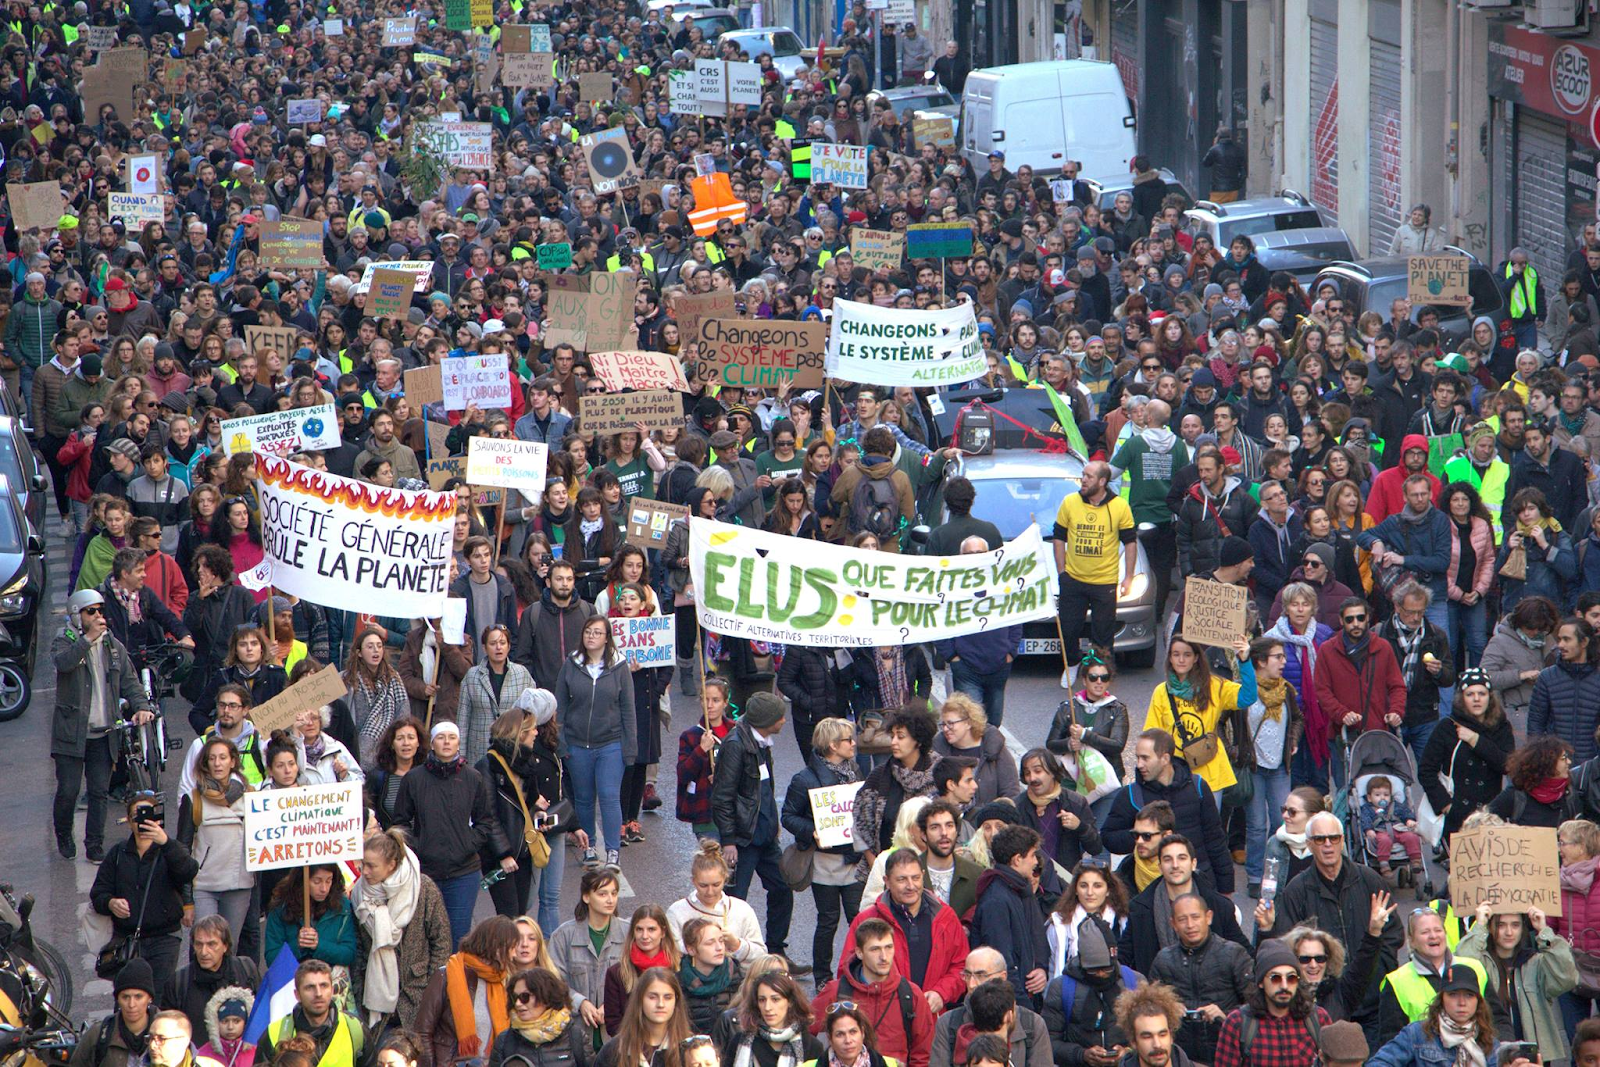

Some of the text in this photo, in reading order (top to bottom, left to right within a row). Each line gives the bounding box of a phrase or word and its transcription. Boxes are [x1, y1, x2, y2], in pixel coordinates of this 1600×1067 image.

[699, 67, 720, 77] CRS
[1556, 51, 1589, 78] AZUR
[676, 82, 685, 90] ET
[700, 78, 719, 86] C'EST
[735, 79, 757, 87] VOTRE
[1556, 72, 1589, 98] SCOOT
[677, 103, 698, 112] TOUT
[581, 135, 594, 147] LA
[814, 144, 866, 160] JE VOTE
[821, 158, 866, 174] POUR LA
[617, 174, 640, 188] NOIR
[110, 204, 138, 213] C'EST
[111, 195, 148, 206] QUAND
[1410, 257, 1467, 271] SAVE THE
[577, 273, 625, 297] NON
[1411, 270, 1470, 288] PLANET
[553, 295, 635, 322] AUX GAZ
[701, 318, 810, 356] Changeons
[840, 319, 938, 340] CHANGEONS
[589, 352, 661, 369] Ni Dieu
[697, 341, 829, 372] le SYSTÈME pas
[838, 340, 935, 363] LE SYSTÈME
[443, 357, 503, 372] TOI AUSSI
[594, 365, 669, 381] Ni Maître
[697, 361, 805, 387] le CLIMAT
[584, 394, 675, 408] EN 2050 IL Y AURA
[585, 404, 677, 418] PLUS DE PLASTIQUE
[583, 420, 599, 431] QUE
[599, 420, 608, 430] DE
[659, 418, 669, 427] LA
[474, 439, 542, 455] SAUVONS LA VIE
[430, 459, 460, 474] MAKE
[495, 455, 514, 465] DES
[502, 466, 541, 480] POISSONS
[261, 490, 335, 543] SOCIÉTÉ
[340, 518, 450, 562] GÉNÉRALE
[1075, 537, 1092, 545] POUR
[262, 521, 447, 596] BRÛLE LA PLANÈTE
[1074, 545, 1103, 556] CLIMAT
[843, 551, 1037, 595] QUE FAITES VOUS
[1189, 580, 1246, 601] TRANSITION
[870, 576, 1051, 631] POUR LE CLIMAT
[1187, 592, 1242, 611] ECOLOGIQUE
[1193, 604, 1229, 621] JUSTICE
[628, 617, 672, 636] BONNE
[703, 612, 744, 633] COLLECTIF
[746, 625, 803, 644] ALTERNATIVES
[617, 632, 656, 650] SANS
[254, 674, 332, 722] NON AU PROJET
[250, 789, 352, 814] LE CHANGEMENT
[813, 790, 837, 810] LES
[280, 805, 345, 824] CLIMATIQUE
[818, 815, 847, 831] SONT
[254, 816, 362, 843] C'EST MAINTENANT!
[257, 838, 345, 866] ARRETONS
[1454, 829, 1536, 864] AVIS DE
[1456, 861, 1558, 884] RECHERCHE
[1456, 887, 1472, 909] LA
